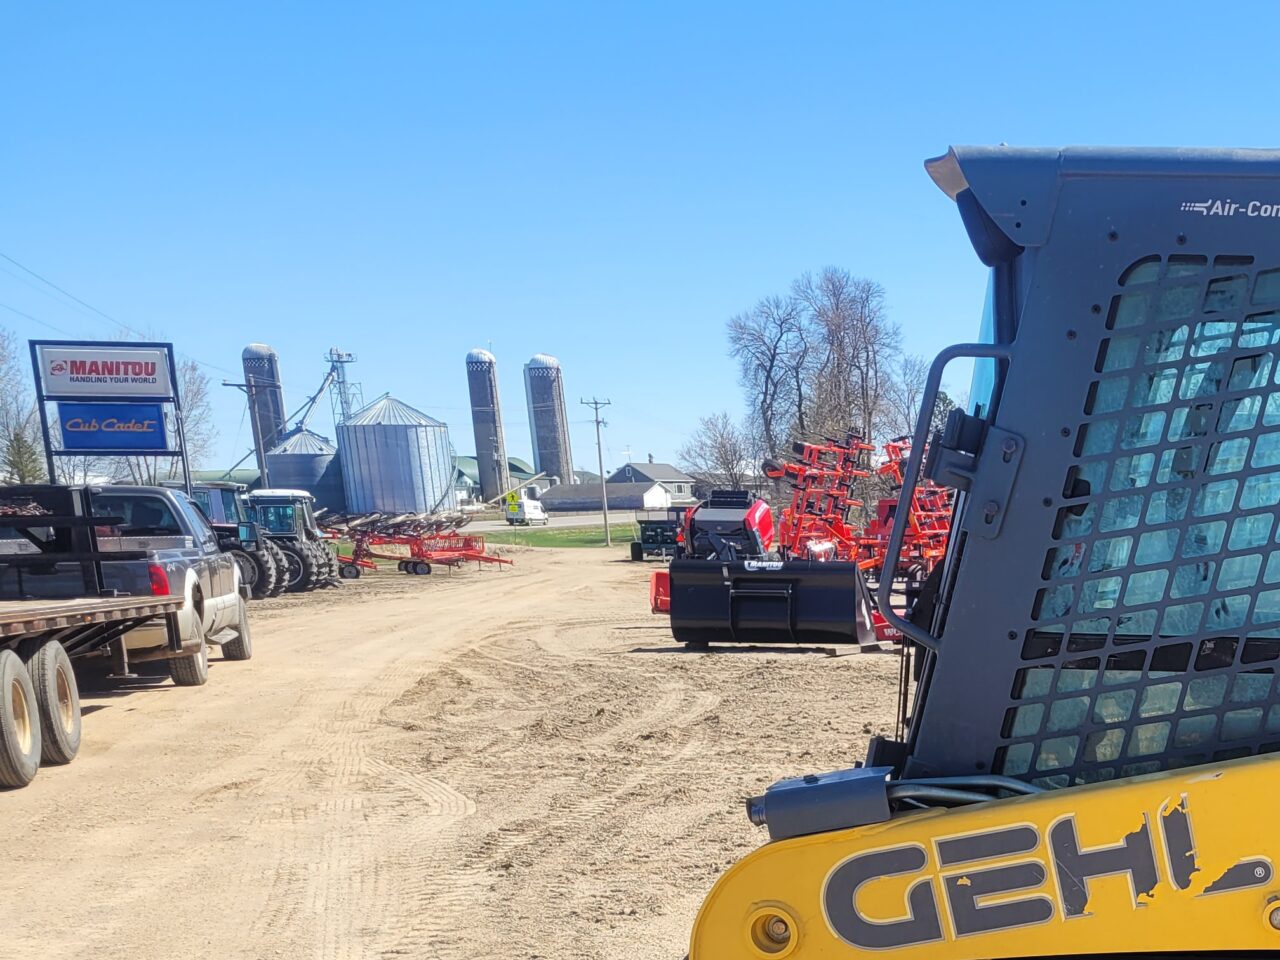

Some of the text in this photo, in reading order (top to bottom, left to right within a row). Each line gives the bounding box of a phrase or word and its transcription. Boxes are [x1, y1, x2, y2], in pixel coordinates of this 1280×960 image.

[69, 360, 157, 376] MANITOU
[69, 376, 108, 384] HANDLING
[109, 376, 129, 384] YOUR
[65, 418, 158, 432] Cub Cadet
